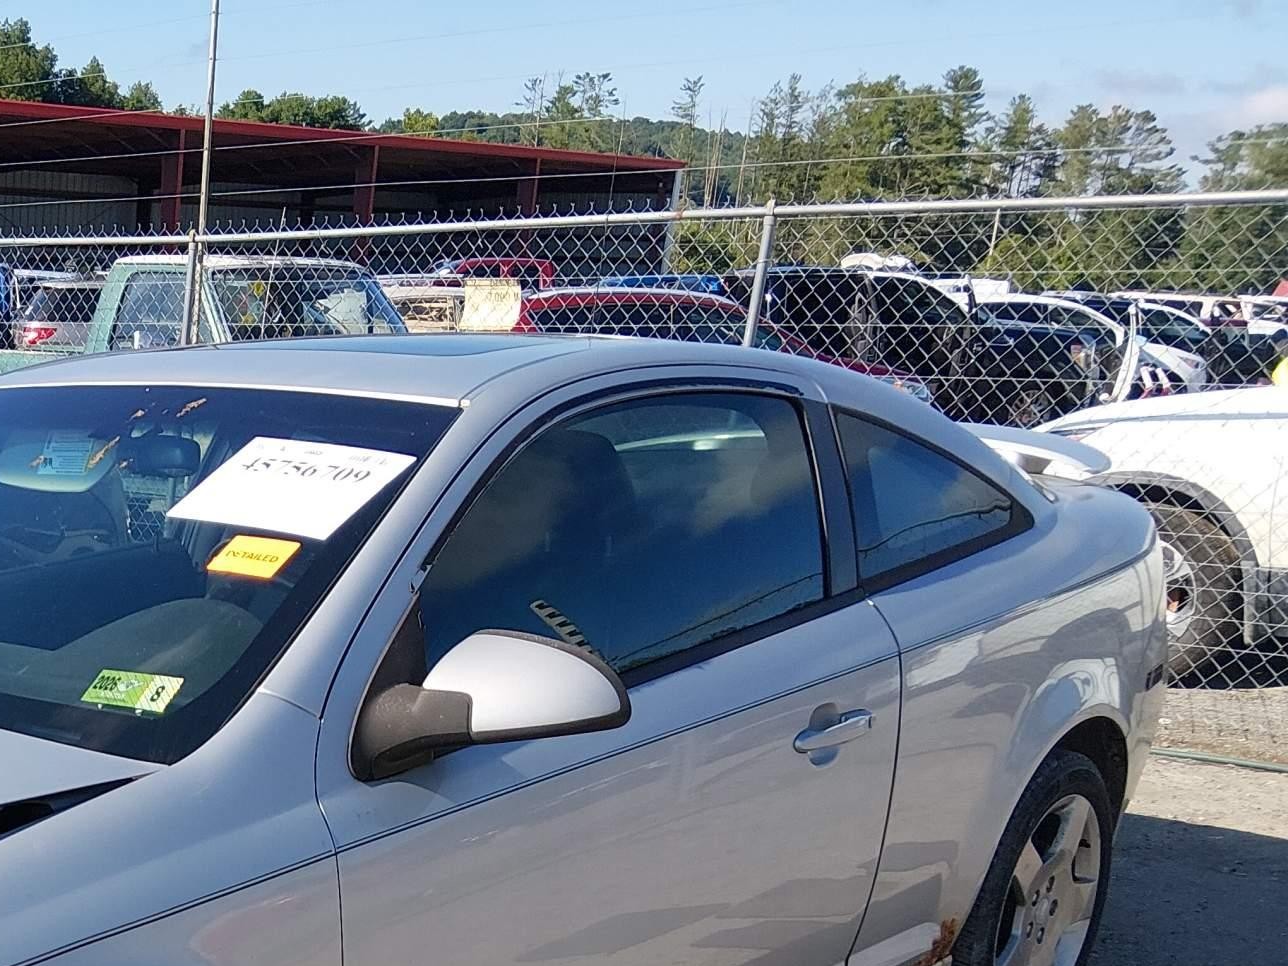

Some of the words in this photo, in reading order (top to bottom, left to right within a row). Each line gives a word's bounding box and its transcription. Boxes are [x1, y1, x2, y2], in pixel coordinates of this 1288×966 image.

[242, 457, 372, 482] 45756709
[225, 550, 279, 563] DETAILED
[92, 674, 121, 691] 2026
[149, 685, 165, 702] 8
